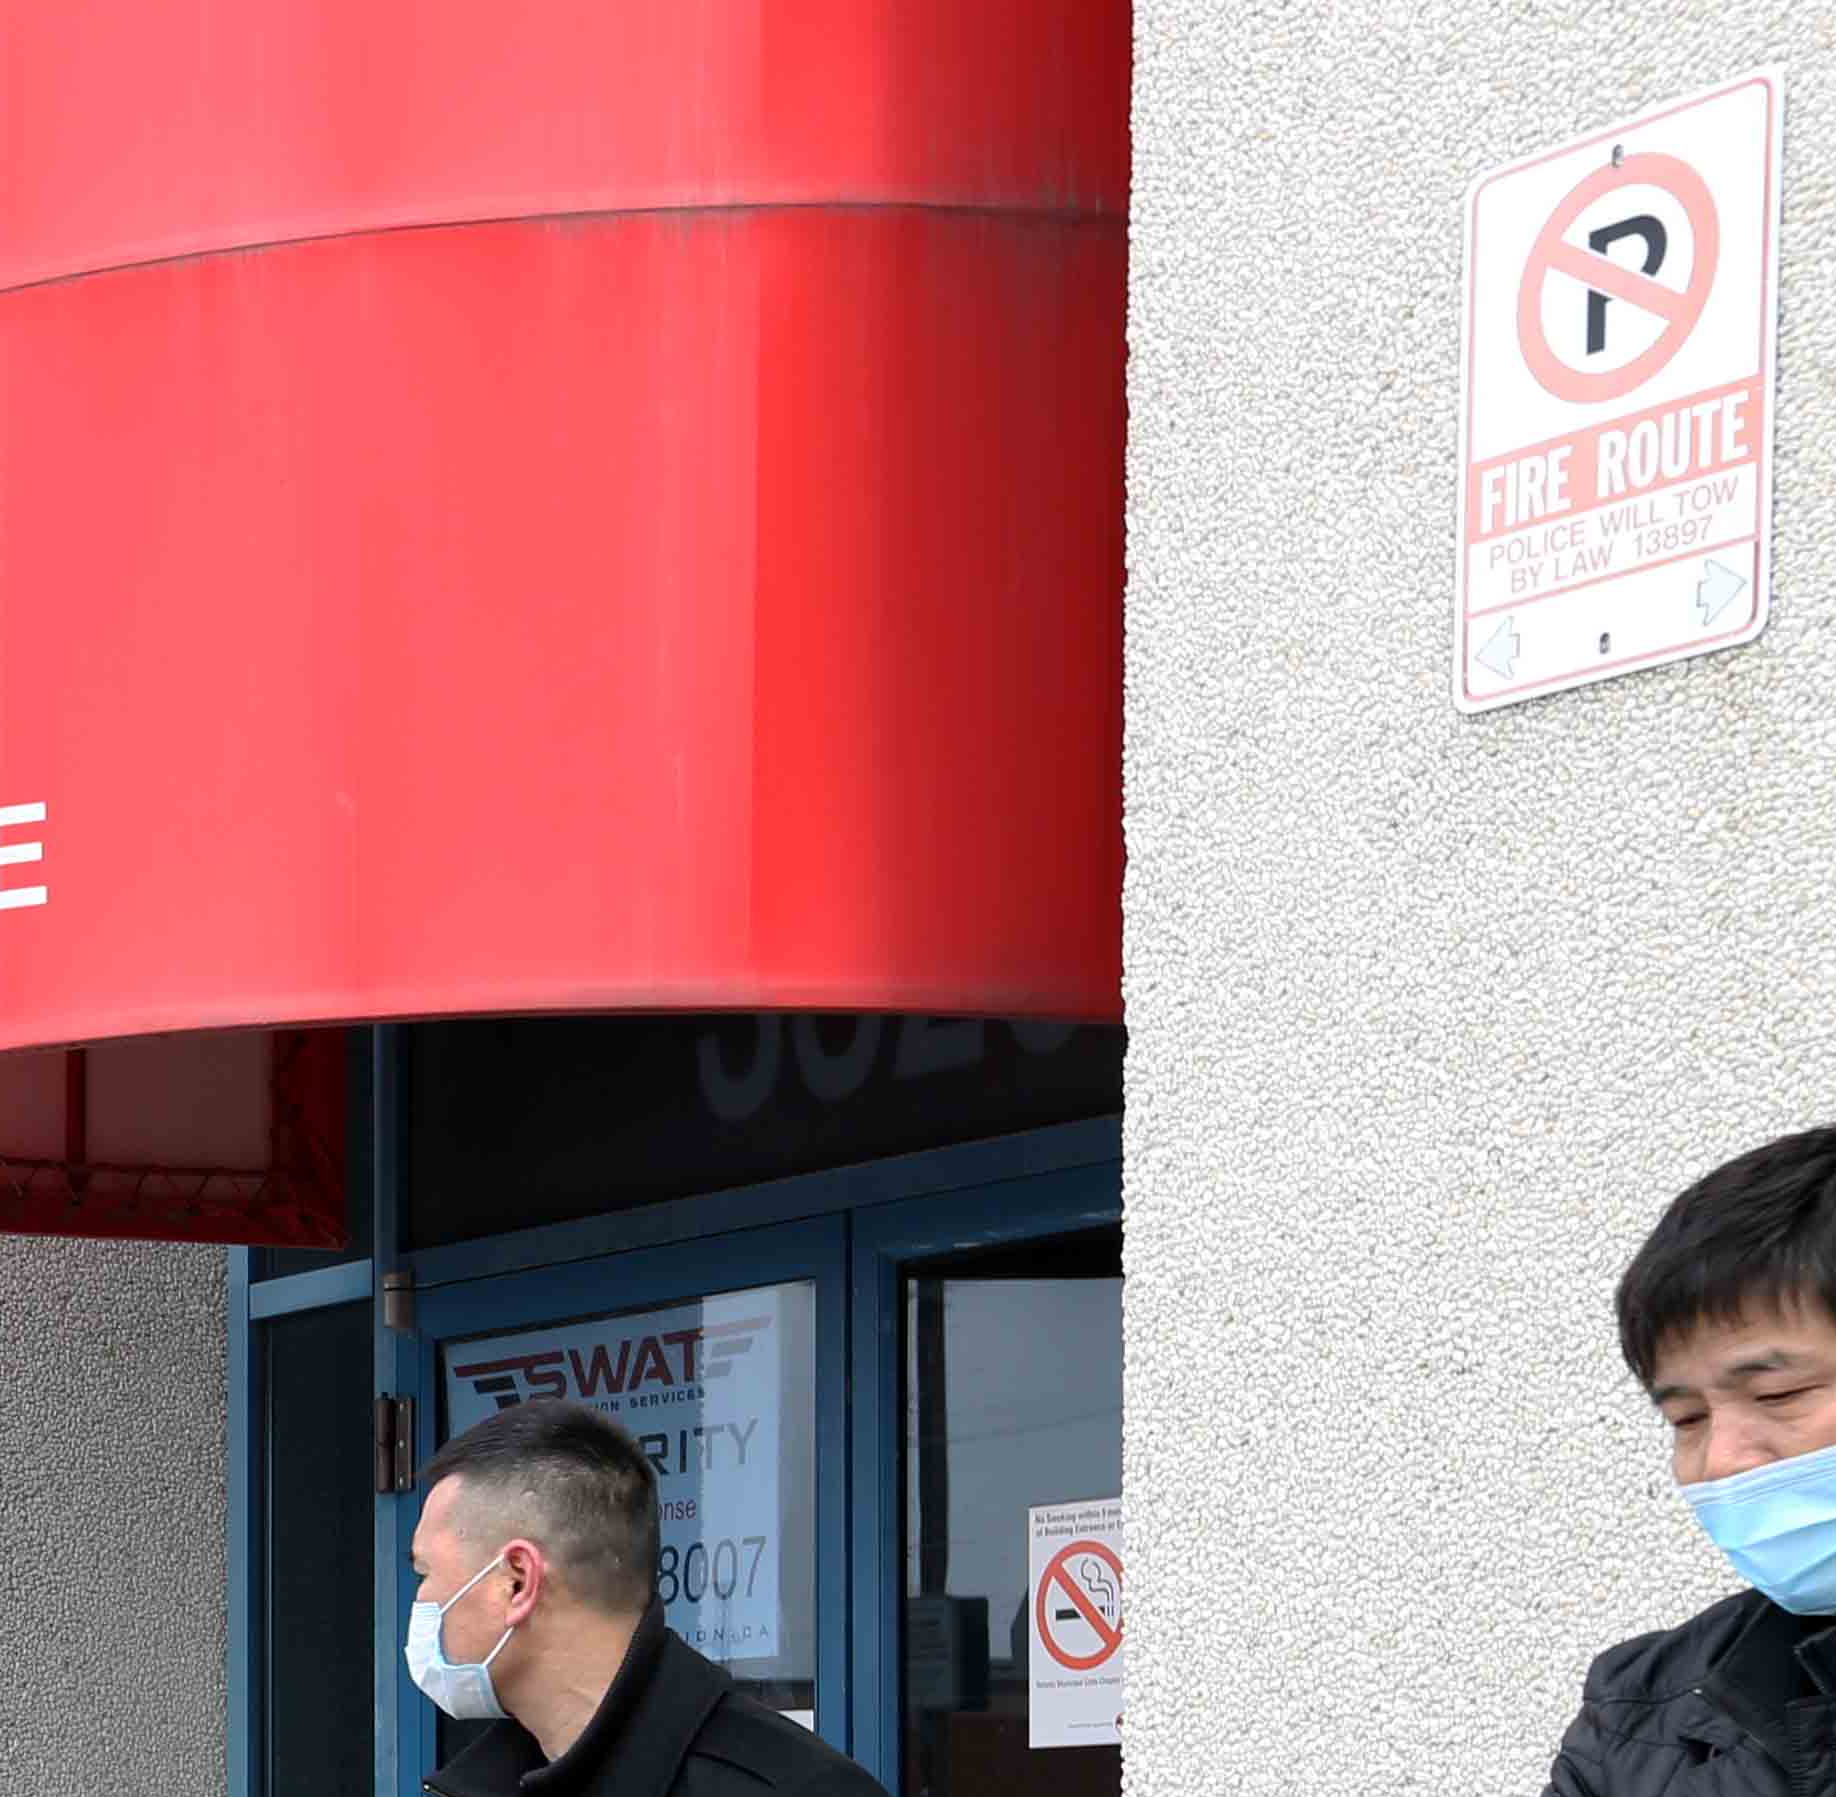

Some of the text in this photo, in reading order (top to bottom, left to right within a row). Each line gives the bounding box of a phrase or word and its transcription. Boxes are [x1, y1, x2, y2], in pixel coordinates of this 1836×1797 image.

[1480, 391, 1750, 536] FIRE ROUTE
[1489, 475, 1739, 569] POLICE WILL TOW
[1511, 514, 1713, 595] BY LAW 13897
[520, 1328, 704, 1401] SWAT
[639, 1418, 759, 1476] RITY
